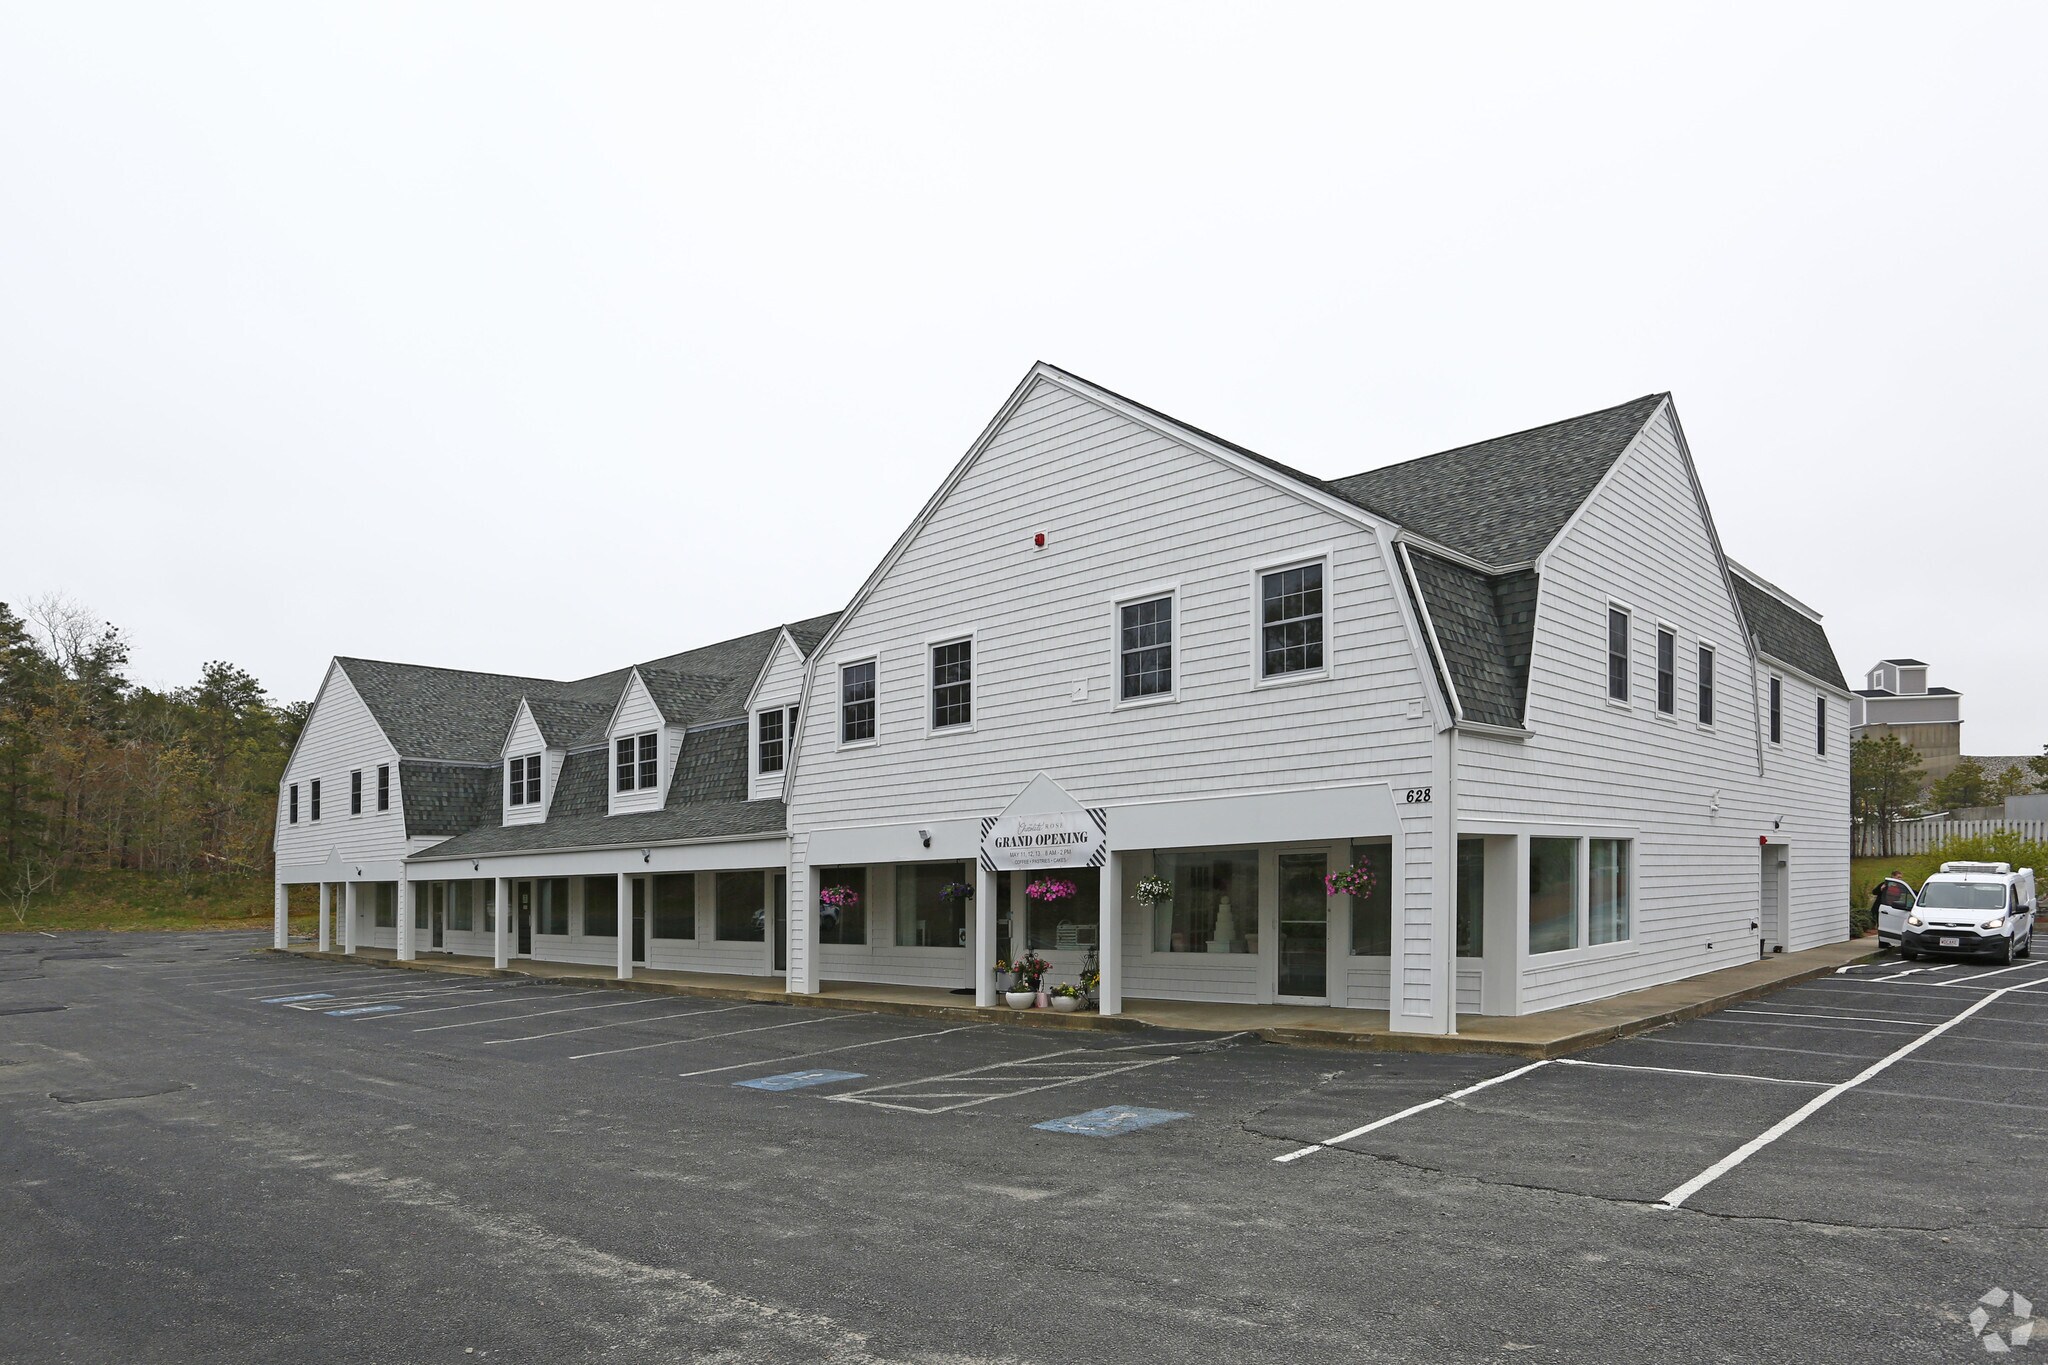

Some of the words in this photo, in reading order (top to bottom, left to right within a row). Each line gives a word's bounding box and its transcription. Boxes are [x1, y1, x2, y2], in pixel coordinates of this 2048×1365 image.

[1406, 788, 1431, 803] 628
[995, 835, 1033, 848] GRAND
[1035, 831, 1088, 846] OPENING
